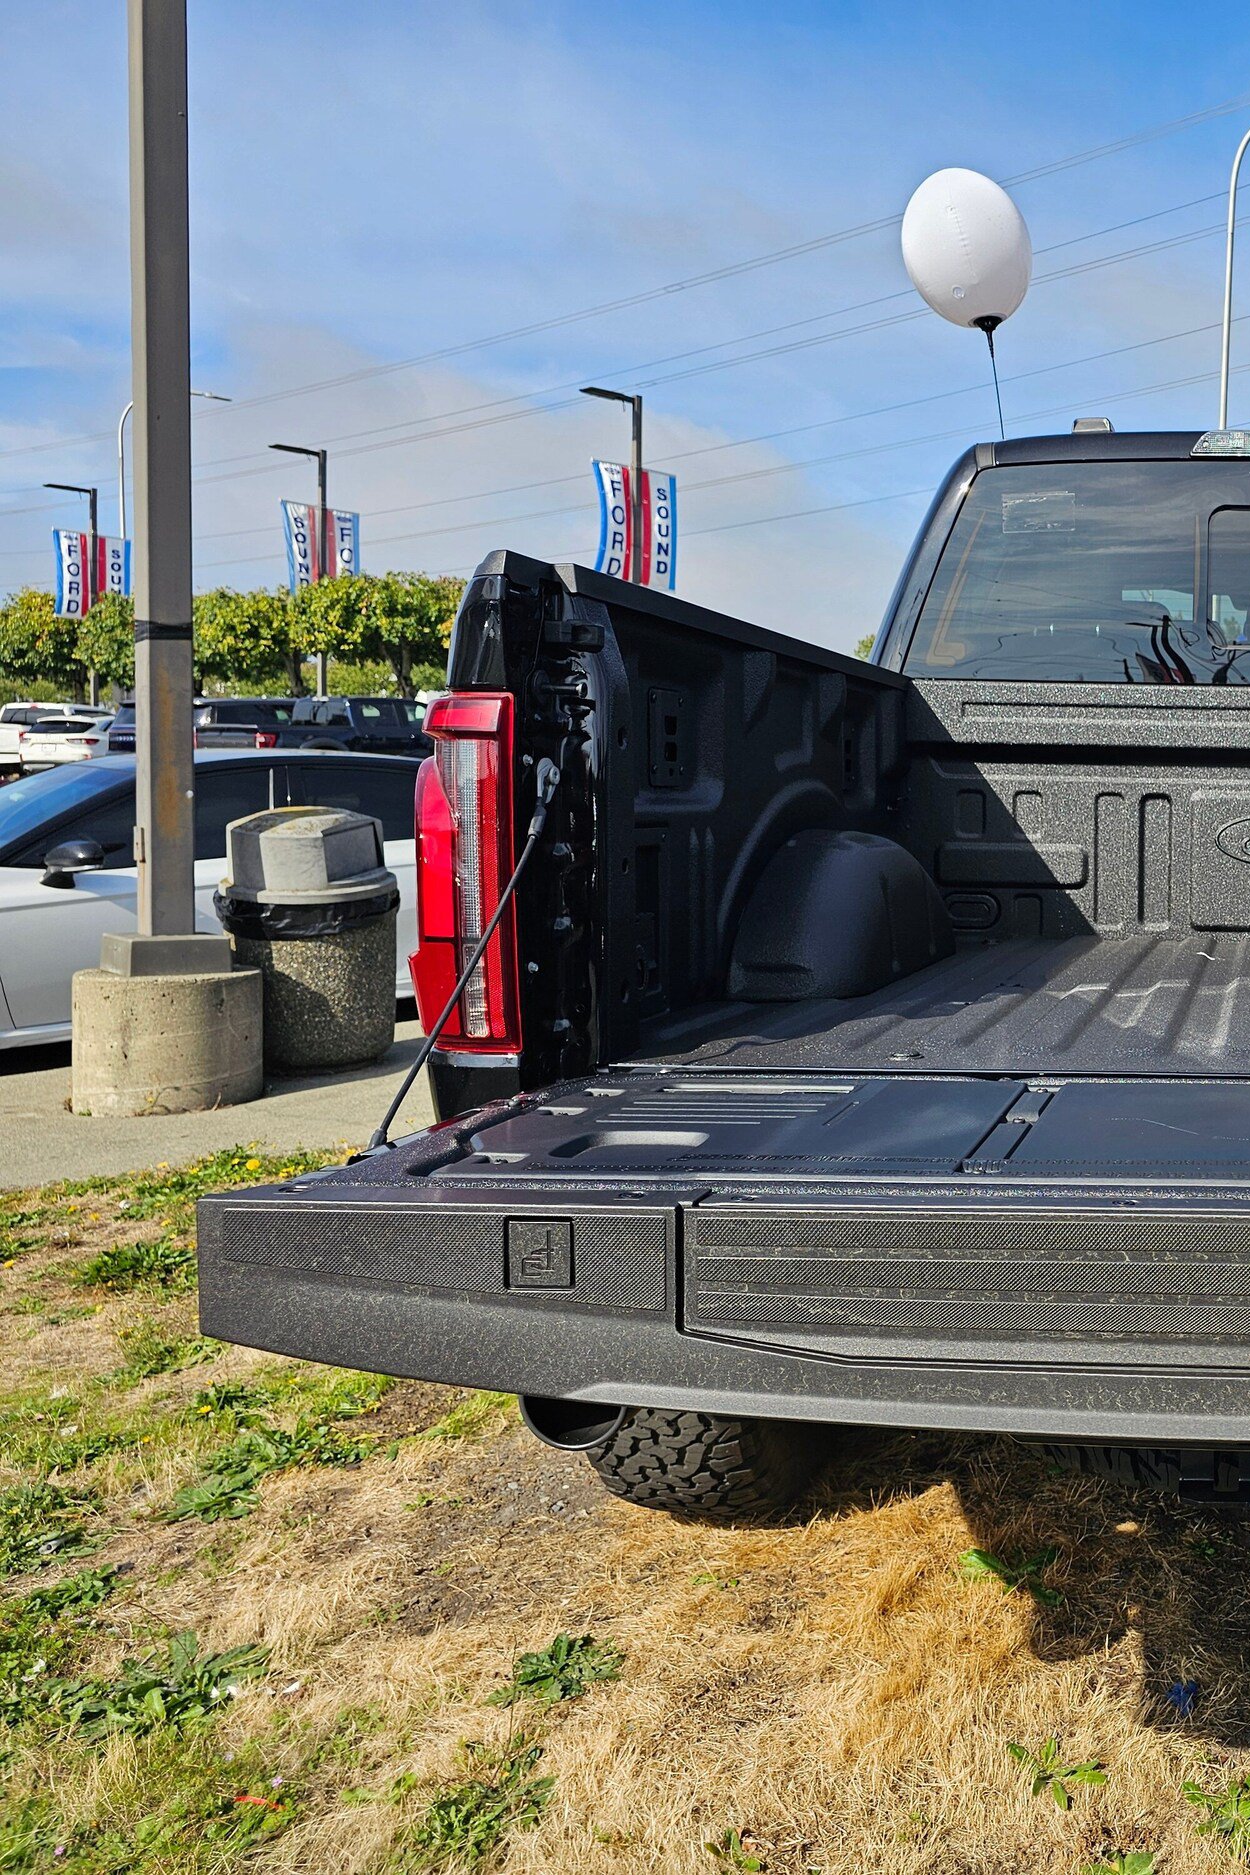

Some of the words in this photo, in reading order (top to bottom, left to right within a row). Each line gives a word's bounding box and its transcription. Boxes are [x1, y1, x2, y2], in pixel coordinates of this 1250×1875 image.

[606, 479, 626, 576] FORD
[656, 487, 670, 574] SOUND
[66, 544, 80, 614] FORD
